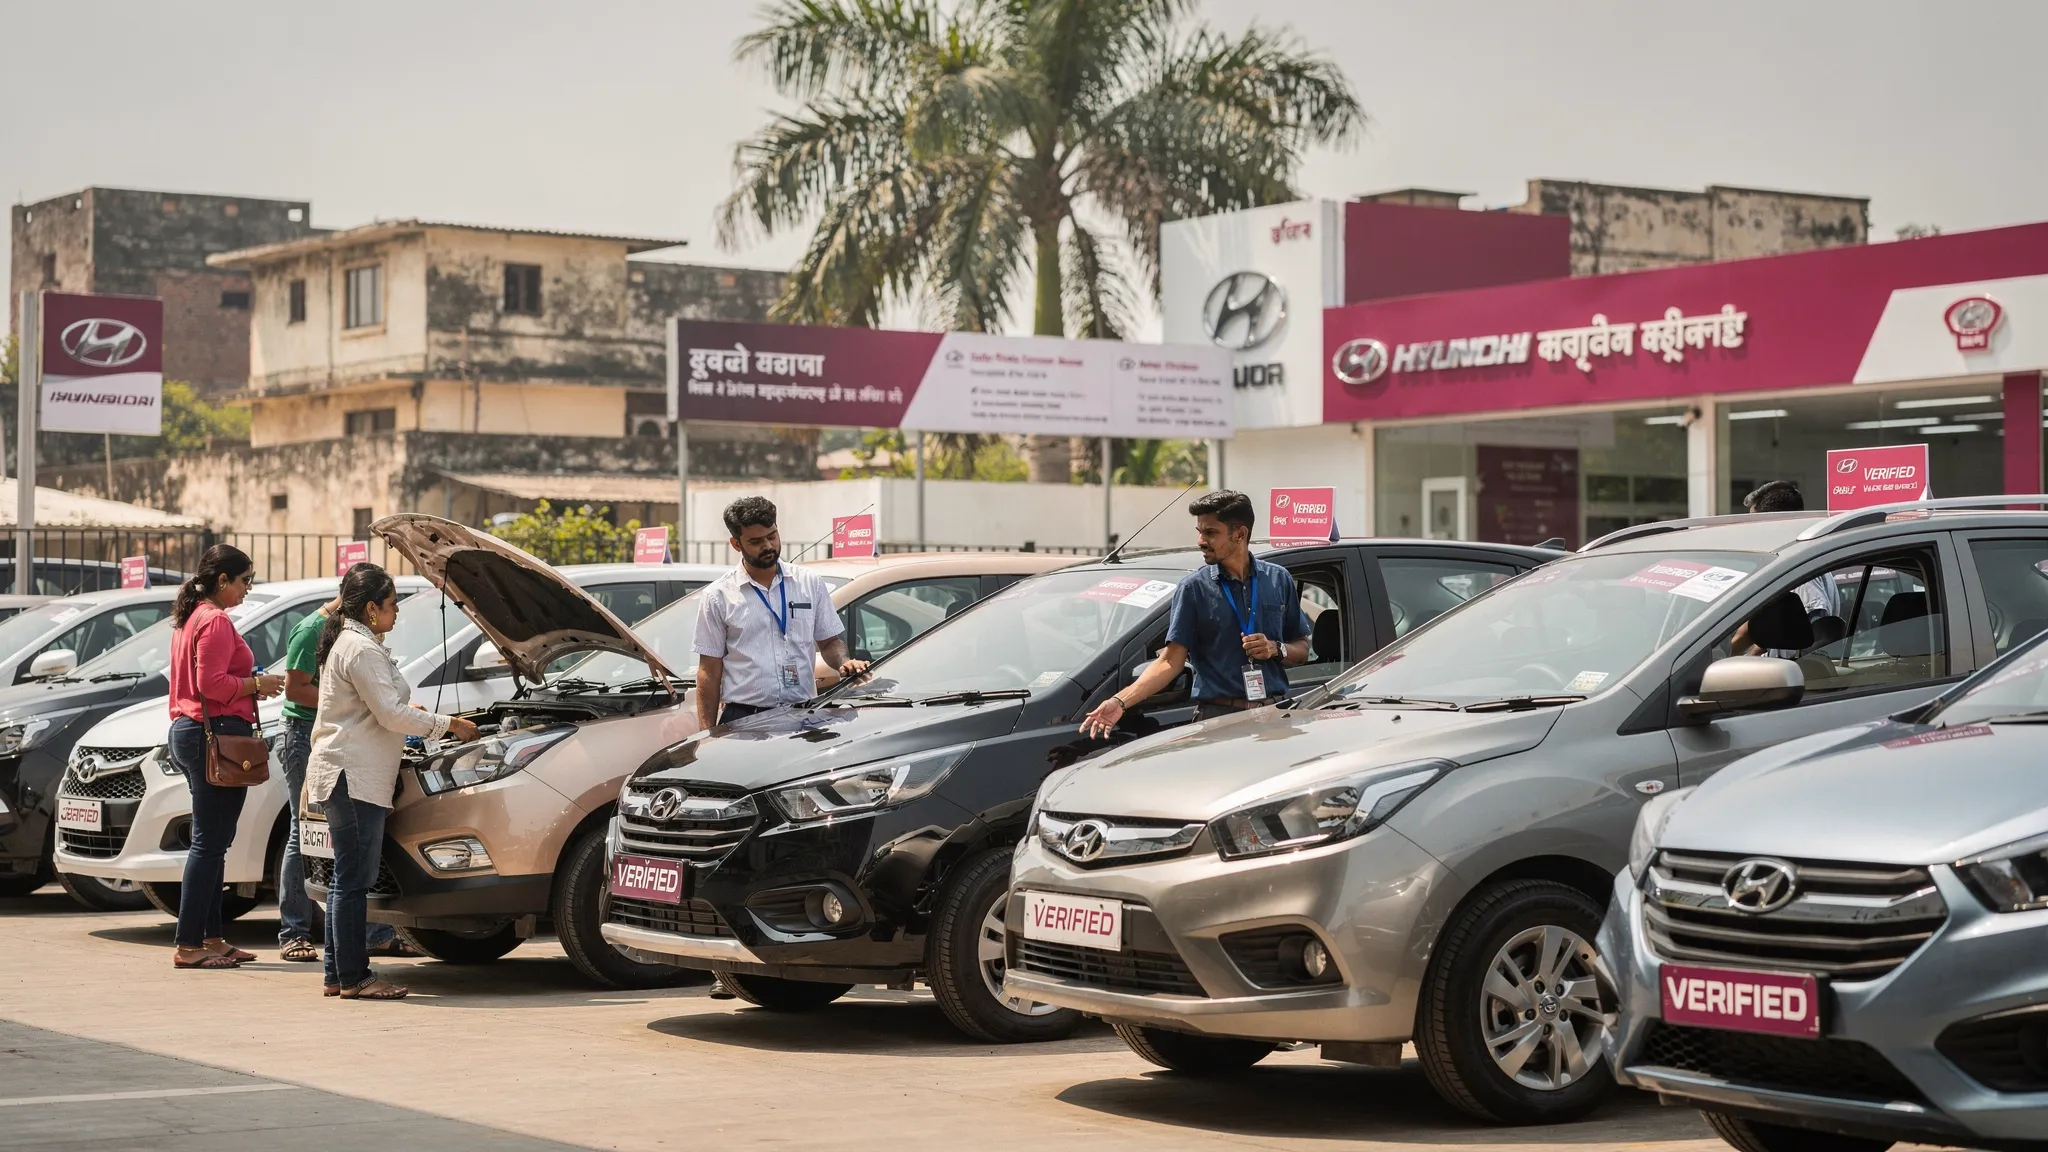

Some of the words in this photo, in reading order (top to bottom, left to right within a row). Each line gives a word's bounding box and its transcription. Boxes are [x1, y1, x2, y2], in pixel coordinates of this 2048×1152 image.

[1863, 465, 1916, 481] VERIFIED
[618, 863, 678, 893] VERIFIED
[1034, 903, 1114, 936] VERIFIED
[1666, 976, 1808, 1022] VERIFIED
